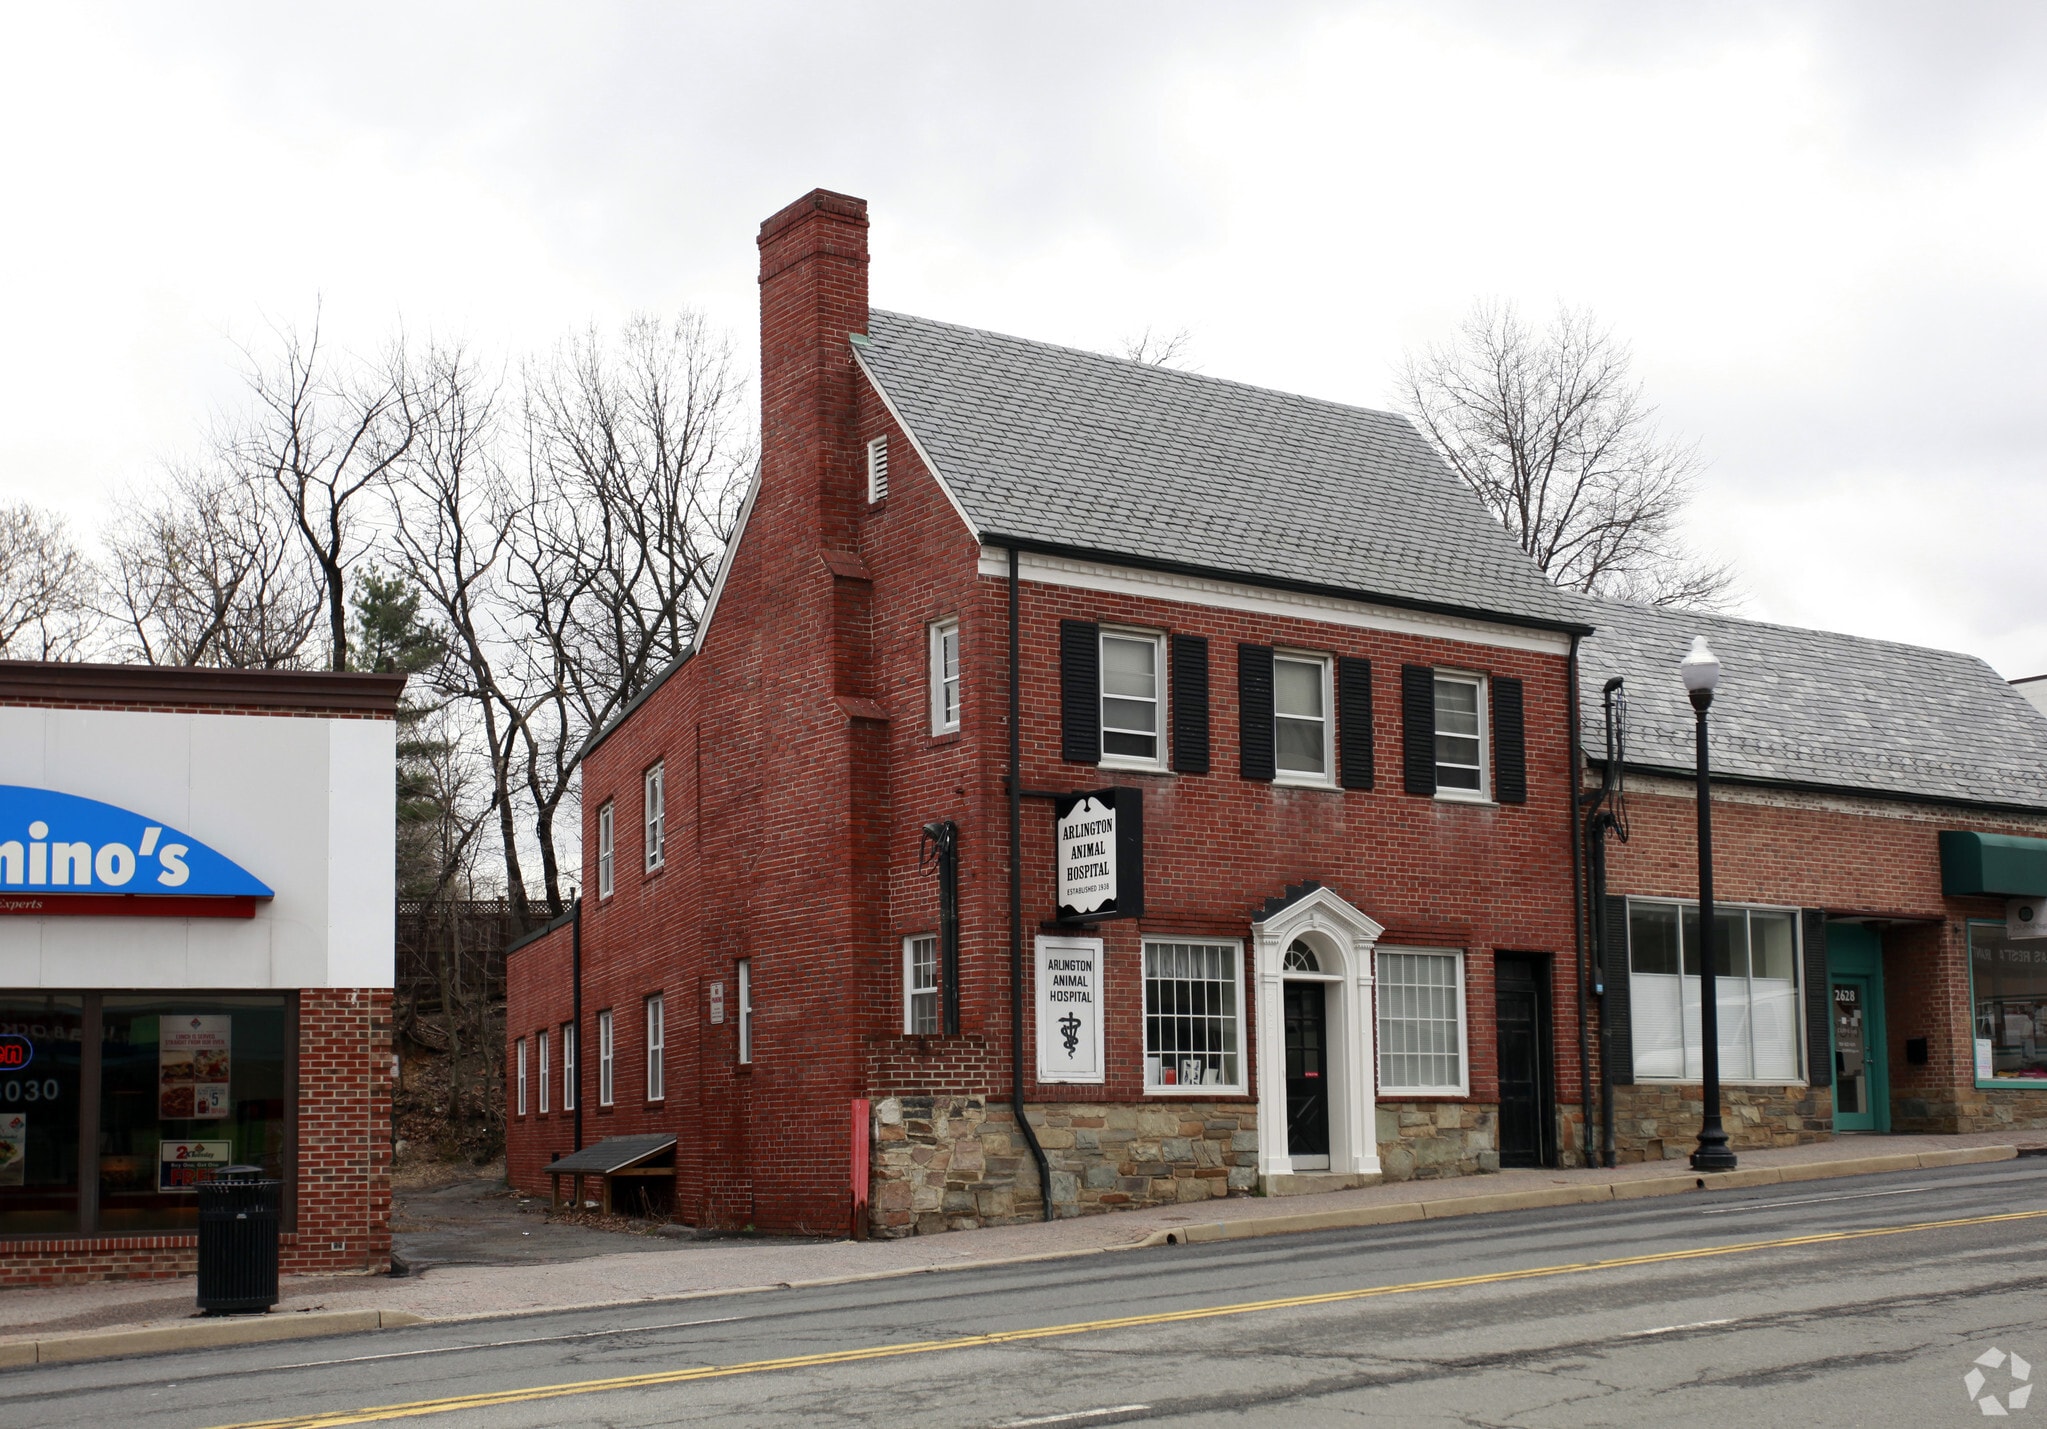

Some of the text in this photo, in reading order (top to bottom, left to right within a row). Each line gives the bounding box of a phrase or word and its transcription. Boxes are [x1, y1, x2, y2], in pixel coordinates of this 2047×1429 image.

[1062, 817, 1113, 841] ARLINGTON
[1070, 841, 1106, 860] ANIMAL
[1066, 861, 1110, 882] HOSPITAL
[1066, 882, 1110, 896] ESTABLISHED 1938
[1047, 958, 1092, 973] ARLINGTON
[1052, 974, 1088, 988] ANIMAL
[1050, 990, 1092, 1003] HOSPITAL
[1835, 990, 1855, 1001] 2628
